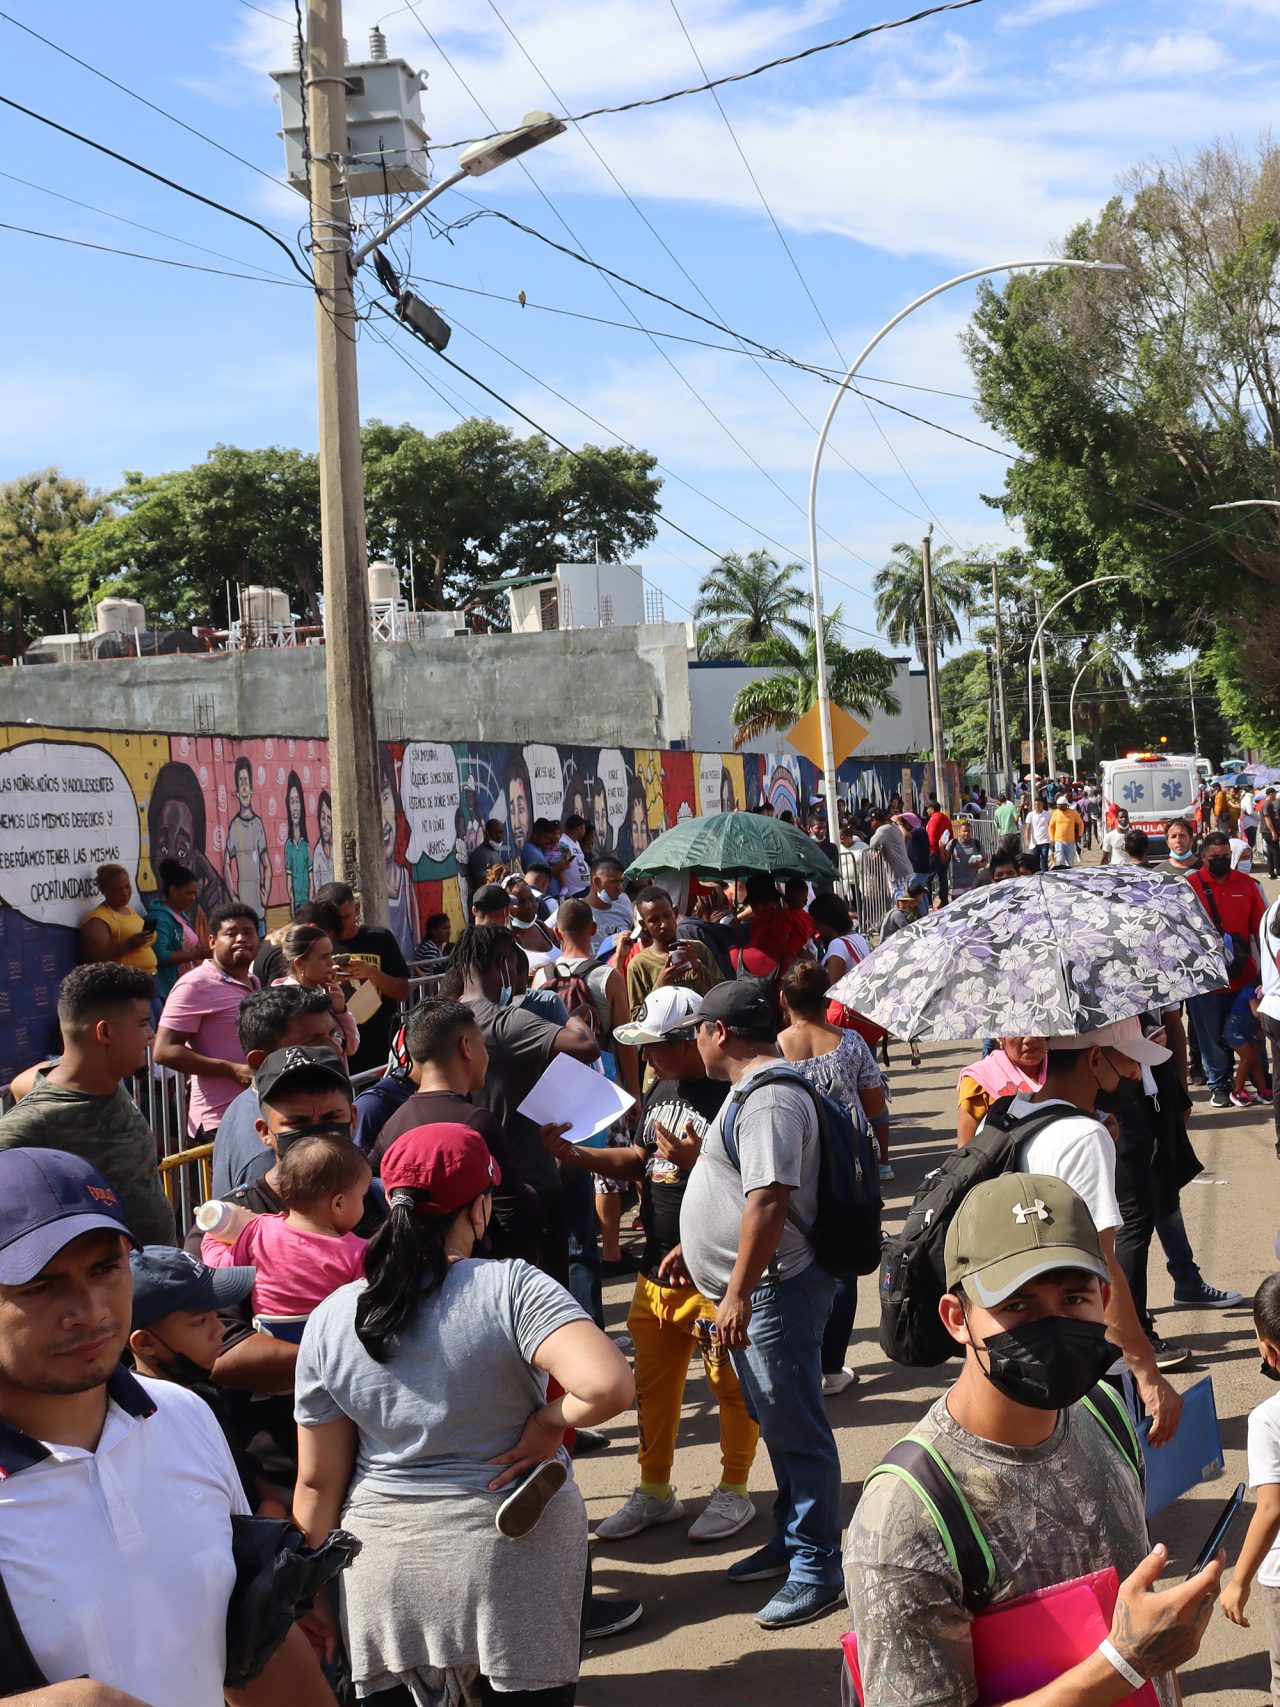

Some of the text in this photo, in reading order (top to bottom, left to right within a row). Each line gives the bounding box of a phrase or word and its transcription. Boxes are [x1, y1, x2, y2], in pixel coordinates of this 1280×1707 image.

[27, 812, 39, 829] LOS
[41, 812, 70, 829] MISMOS
[72, 811, 104, 828] DERECHOS
[106, 810, 113, 826] Y
[46, 848, 70, 865] TENER
[73, 847, 87, 864] LAS
[90, 845, 120, 862] MISMAS
[31, 878, 99, 902] OPORTUNIDADES
